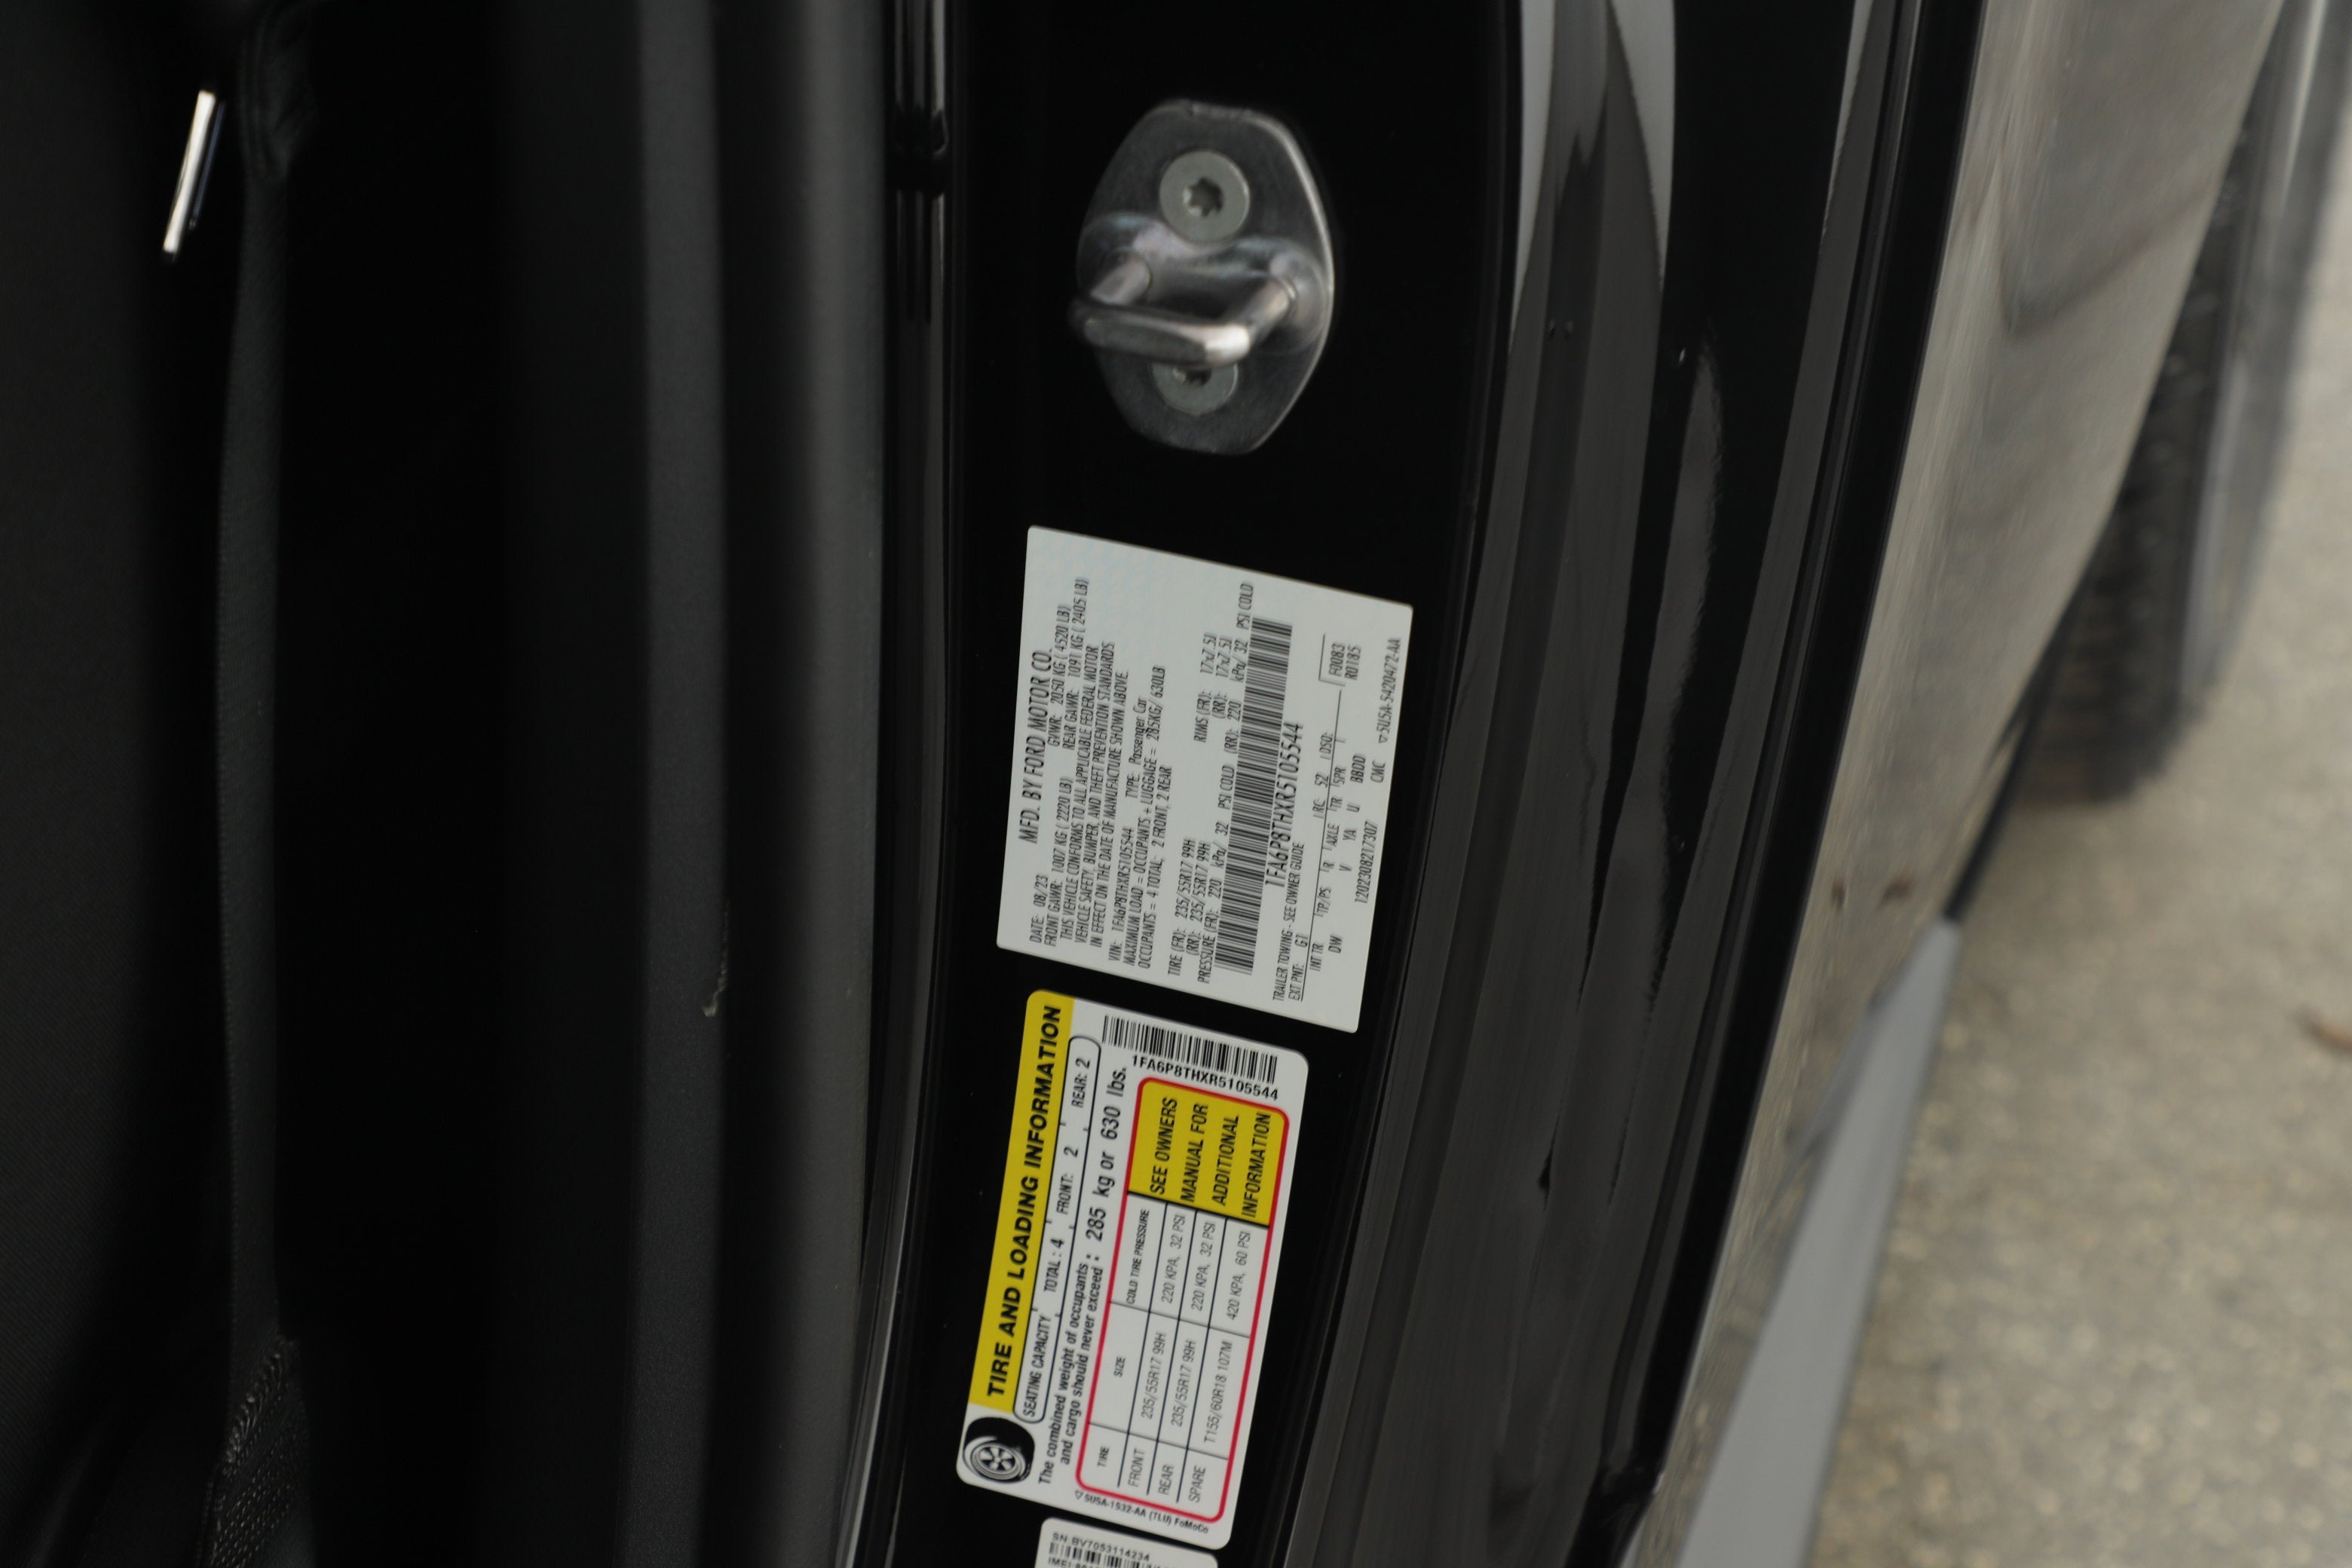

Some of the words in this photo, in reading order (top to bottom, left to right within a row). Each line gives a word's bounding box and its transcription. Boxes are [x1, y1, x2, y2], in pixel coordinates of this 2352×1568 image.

[1071, 598, 1086, 625] 2405
[1238, 583, 1254, 611] COLD
[1236, 612, 1251, 629] PSI
[1054, 624, 1069, 652] 4520
[1070, 634, 1084, 651] KG
[1233, 639, 1248, 654] 32
[1031, 648, 1052, 672] CO.
[1052, 661, 1066, 677] KG
[1083, 645, 1098, 682] MOTOR
[1097, 642, 1114, 700] STANDARDS
[1049, 678, 1064, 705] 2050
[1150, 666, 1165, 698] 630LB
[1027, 676, 1050, 731] MOTOR
[1064, 690, 1080, 722] GAWR:
[1080, 685, 1096, 727] FEDERAL
[1132, 697, 1147, 714] Car
[1227, 700, 1242, 721] 220
[1046, 715, 1062, 746] GVWR:
[1061, 724, 1076, 750] REAR
[1092, 703, 1109, 764] PREVENTION
[1109, 708, 1125, 745] SHOWN
[1193, 717, 1208, 743] RIMS
[1023, 735, 1046, 776] FORD
[1075, 728, 1092, 786] APPLICABLE
[1128, 717, 1149, 767] Passenger
[1021, 779, 1042, 801] BY
[1089, 765, 1104, 794] THEFT
[1103, 747, 1122, 819] MANUFACTURE
[1125, 773, 1141, 798] TYPE:
[1140, 758, 1157, 805] LUGGAGE
[1156, 765, 1171, 792] REAR
[1219, 764, 1235, 792] COLD
[1055, 795, 1070, 822] 2220
[1073, 788, 1087, 806] ALL
[1087, 796, 1101, 819] AND
[1155, 792, 1170, 801] 2
[1217, 793, 1232, 810] PSI
[1265, 722, 1303, 887] 1FA6P8THXR5105544
[1018, 807, 1040, 844] MFD.
[1071, 806, 1086, 820] TO
[1101, 820, 1114, 835] OF
[1152, 805, 1170, 838] FRONT,
[1054, 830, 1067, 847] KG
[1083, 822, 1100, 865] BUMPER,
[1150, 839, 1165, 848] 2
[1214, 821, 1229, 836] 32
[1051, 847, 1066, 873] 1007
[1066, 822, 1084, 875] CONFORMS
[1098, 836, 1113, 862] DATE
[1132, 817, 1150, 874] OCCUPANTS
[1181, 839, 1196, 858] 99H
[1196, 842, 1210, 862] 99H
[1289, 842, 1304, 871] GUIDE
[1078, 868, 1095, 903] SAFETY,
[1096, 862, 1111, 881] THE
[1033, 874, 1049, 907] 08/23
[1047, 880, 1063, 912] GAWR:
[1062, 877, 1079, 915] VEHICLE
[1094, 884, 1108, 899] ON
[1129, 887, 1144, 914] LOAD
[1146, 890, 1159, 899] 4
[1174, 860, 1193, 919] 235/55R17
[1189, 864, 1208, 922] 235/55R17
[1207, 877, 1222, 899] 220
[1285, 871, 1300, 905] OWNER
[1059, 917, 1074, 940] THIS
[1074, 904, 1091, 943] VEHICLE
[1091, 900, 1107, 934] EFFECT
[1282, 905, 1297, 923] SEE
[1029, 916, 1044, 943] DATE:
[1043, 914, 1058, 947] FRONT
[1089, 936, 1103, 948] IN
[1123, 915, 1141, 966] MAXIMUM
[1138, 912, 1156, 969] OCCUPANTS
[1108, 942, 1122, 961] VIN:
[1197, 935, 1215, 984] PRESSURE
[1277, 929, 1293, 964] TOWING
[1167, 954, 1183, 975] TIRE
[1272, 966, 1288, 1001] TRAILER
[1074, 1057, 1090, 1069] 2
[1133, 1055, 1278, 1099] 1FA6P8THXR5105544
[1024, 1006, 1060, 1168] INFORMATION
[1070, 1073, 1087, 1107] REAR:
[1106, 1067, 1126, 1097] lbs.
[1100, 1105, 1121, 1140] 630
[1154, 1098, 1178, 1162] OWNERS
[1190, 1103, 1208, 1135] FOR
[1063, 1146, 1079, 1157] 2
[1100, 1150, 1114, 1170] or
[1212, 1116, 1239, 1205] ADDITIONAL
[1242, 1113, 1270, 1217] INFORMATION
[1092, 1175, 1115, 1197] kg
[1149, 1165, 1168, 1195] SEE
[1180, 1140, 1203, 1202] MANUAL
[1055, 1174, 1073, 1214] FRONT:
[1007, 1176, 1038, 1279] LOADING
[1085, 1207, 1106, 1241] 285
[1134, 1209, 1150, 1256] PRESSURE
[1171, 1214, 1186, 1232] PSI
[1202, 1221, 1216, 1240] PSI
[1049, 1238, 1064, 1248] 4
[1169, 1233, 1183, 1250] 32
[1199, 1241, 1213, 1257] 32
[1237, 1230, 1251, 1248] PSI
[1130, 1257, 1142, 1277] TIRE
[1234, 1250, 1248, 1266] 60
[1069, 1263, 1089, 1328] occupants
[1087, 1266, 1103, 1312] exceed
[1125, 1279, 1138, 1305] COLD
[1160, 1282, 1175, 1303] 220
[1190, 1289, 1205, 1312] 220
[998, 1287, 1021, 1337] AND
[1226, 1298, 1240, 1320] 420
[1031, 1315, 1050, 1368] CAPACITY
[1064, 1330, 1077, 1344] of
[1080, 1314, 1095, 1351] never
[987, 1342, 1012, 1395] TIRE
[1058, 1347, 1075, 1390] weight
[1071, 1353, 1089, 1397] should
[1113, 1356, 1125, 1377] SIZE
[1141, 1356, 1161, 1419] 235/55R17
[1152, 1332, 1165, 1355] 99H
[1022, 1371, 1042, 1416] SEATING
[1170, 1364, 1191, 1427] 235/55R17
[1181, 1340, 1196, 1362] 99H
[1203, 1374, 1227, 1442] T155/60R18
[1217, 1340, 1233, 1370] 107M
[1046, 1394, 1066, 1457] combined
[1065, 1400, 1082, 1437] cargo
[1060, 1439, 1073, 1465] and
[1097, 1447, 1110, 1466] TIRE
[1127, 1447, 1144, 1487] FRONT
[1037, 1460, 1054, 1484] The
[1157, 1464, 1174, 1495] REAR
[1188, 1465, 1206, 1502] SPARE
